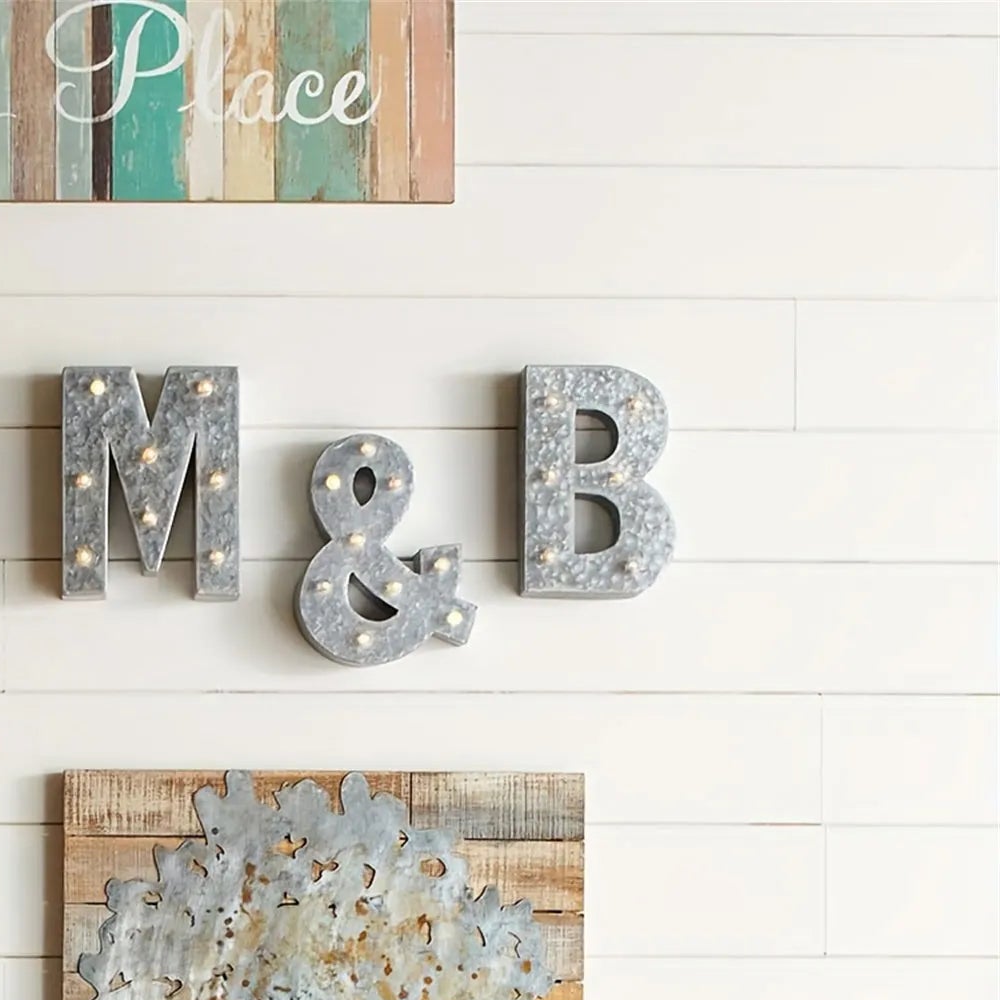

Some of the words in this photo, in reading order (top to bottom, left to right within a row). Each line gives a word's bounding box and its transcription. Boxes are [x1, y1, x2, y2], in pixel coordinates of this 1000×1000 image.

[45, 0, 383, 126] Place
[61, 365, 240, 600] M
[519, 364, 677, 599] B
